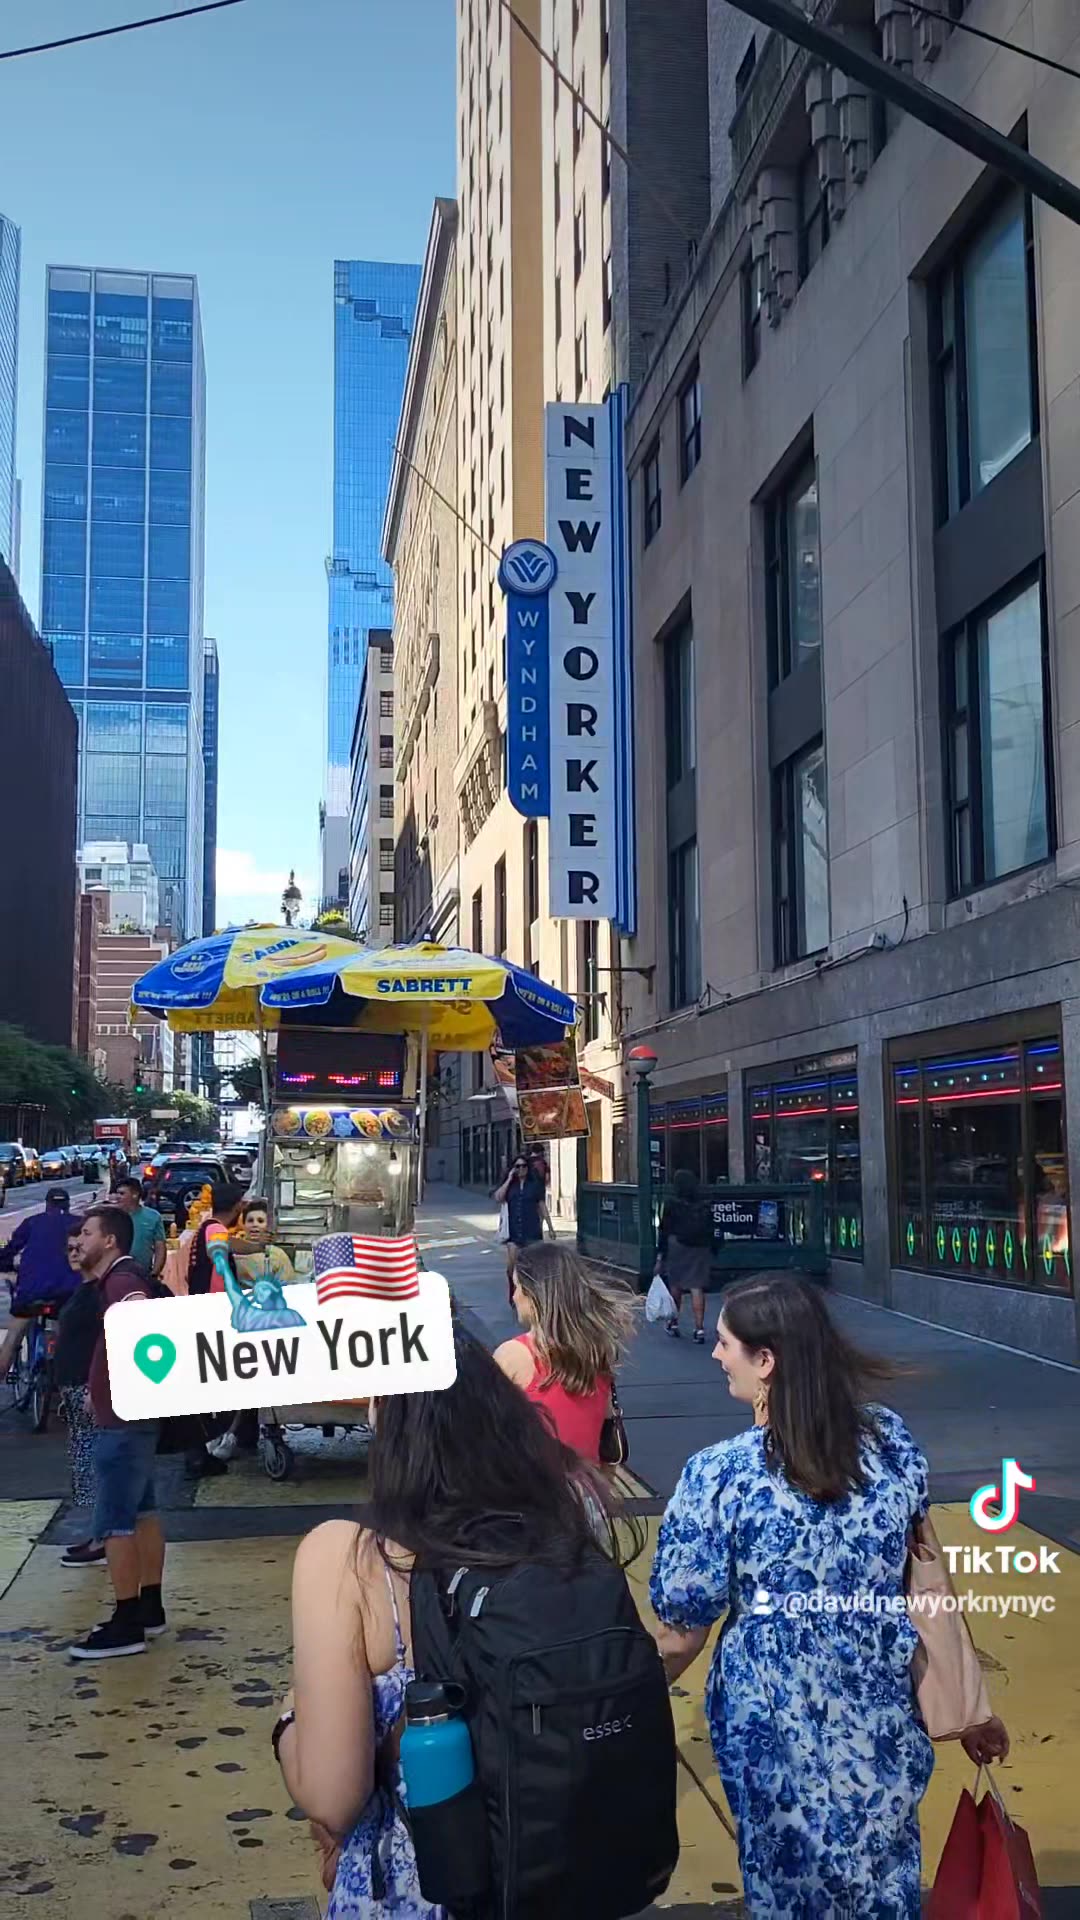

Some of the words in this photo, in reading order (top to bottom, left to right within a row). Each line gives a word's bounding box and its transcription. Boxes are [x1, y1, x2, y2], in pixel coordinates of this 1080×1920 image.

[558, 415, 601, 554] NEW
[516, 611, 540, 800] WYNDHAM
[562, 591, 601, 905] YORKER
[376, 977, 473, 993] SABRETT
[713, 1211, 753, 1223] Station
